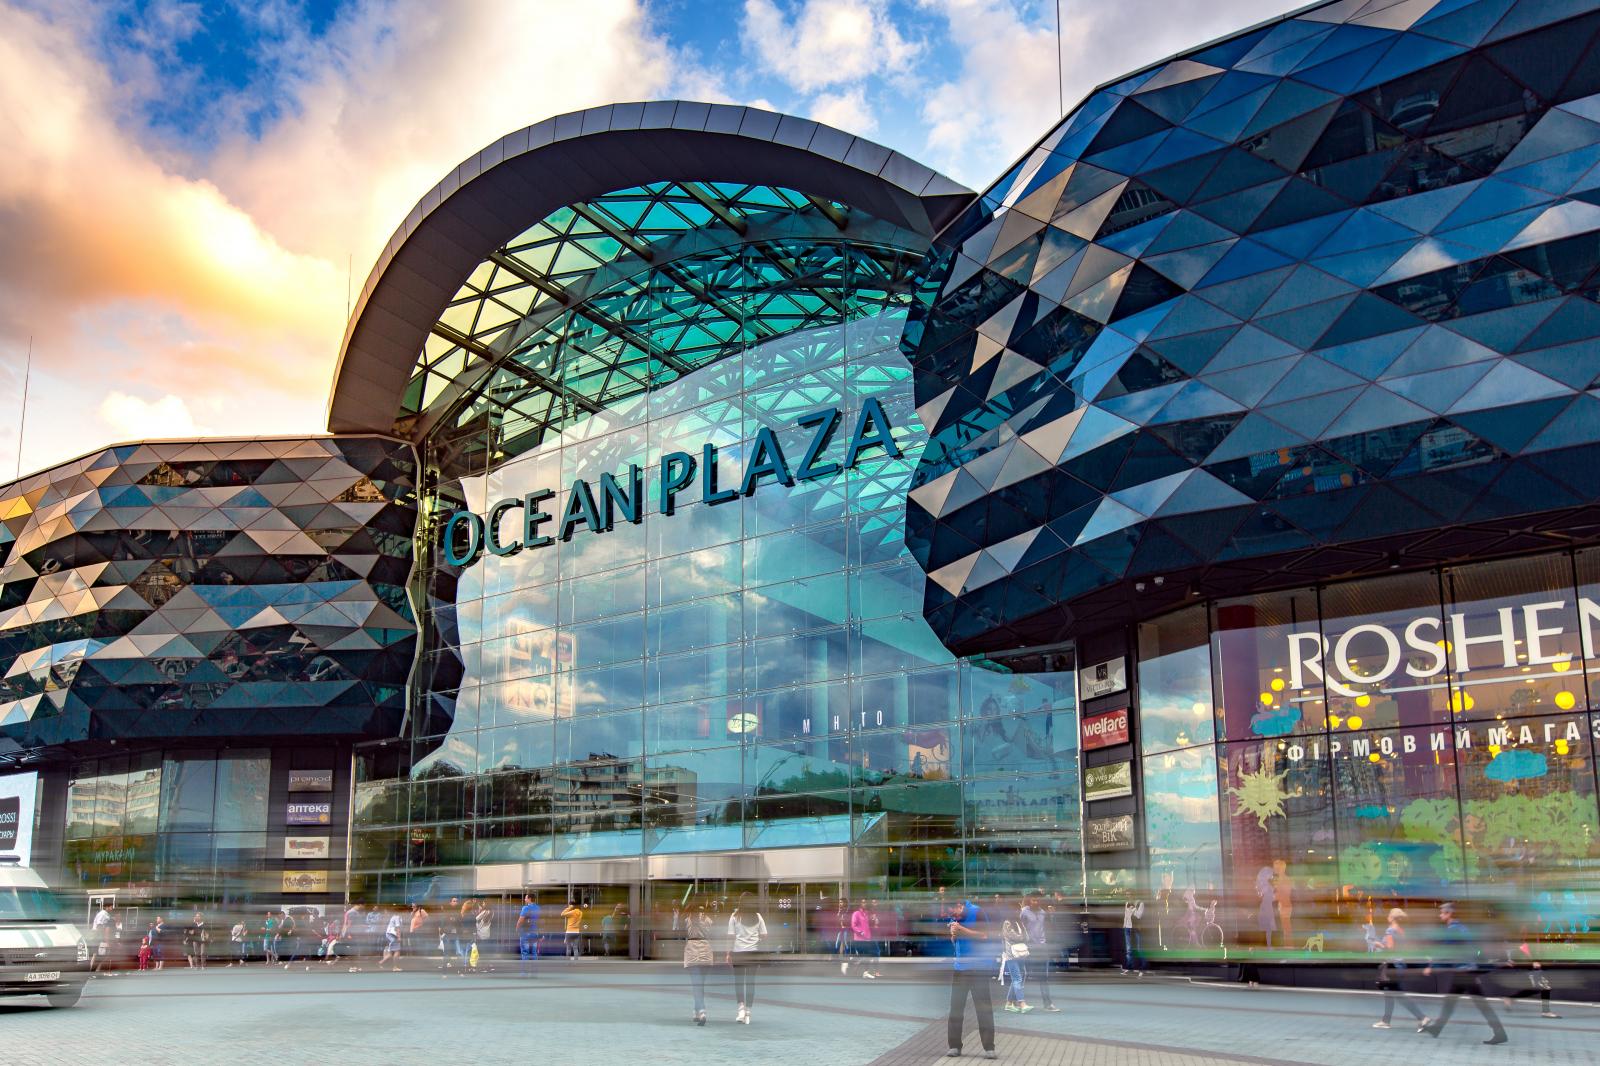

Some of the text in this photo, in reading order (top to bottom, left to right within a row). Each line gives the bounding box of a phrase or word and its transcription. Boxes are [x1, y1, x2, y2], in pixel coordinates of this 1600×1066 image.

[443, 396, 904, 568] OCEAN PLAZA
[1083, 716, 1127, 737] welfare
[1287, 729, 1471, 761] ФІРМОВИЙ
[290, 775, 331, 783] promod
[288, 805, 329, 813] аптека
